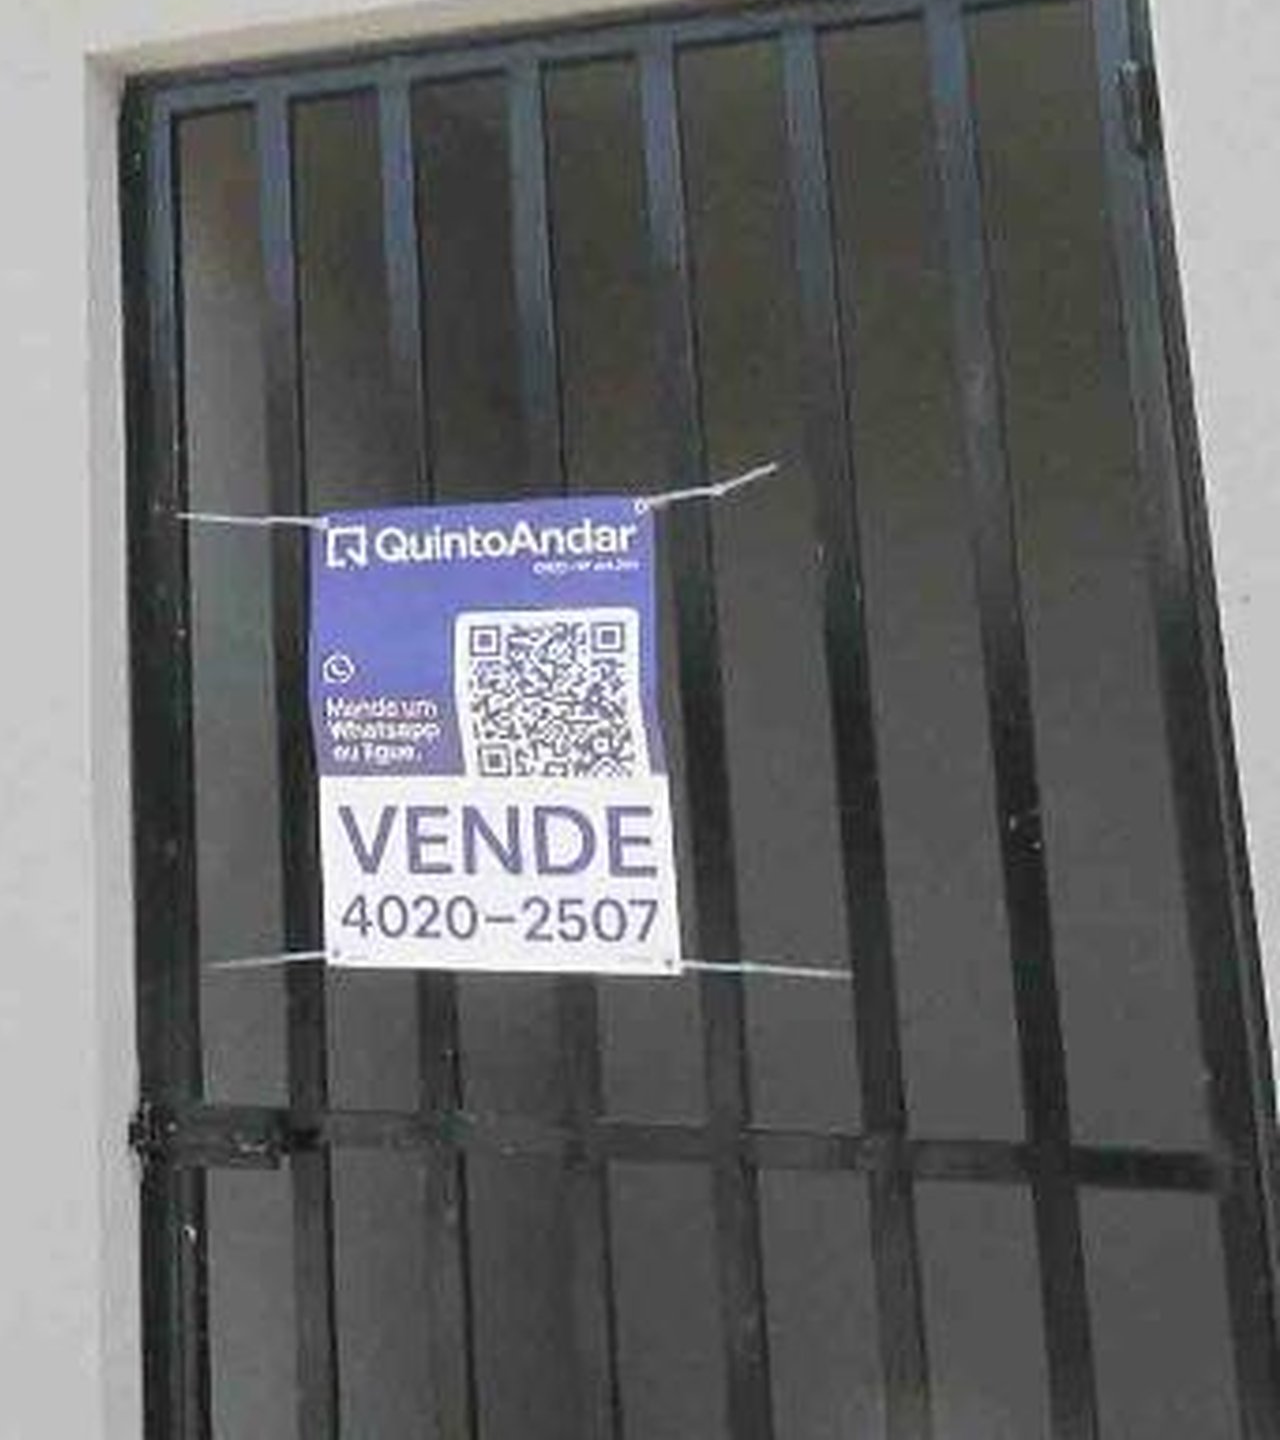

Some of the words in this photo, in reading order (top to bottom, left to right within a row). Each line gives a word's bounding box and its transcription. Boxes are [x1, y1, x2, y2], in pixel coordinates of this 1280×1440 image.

[374, 519, 638, 561] QuintoAndar
[402, 699, 438, 718] um
[333, 744, 359, 762] ou
[337, 805, 659, 878] VENDE
[340, 894, 660, 943] 4020-2507
